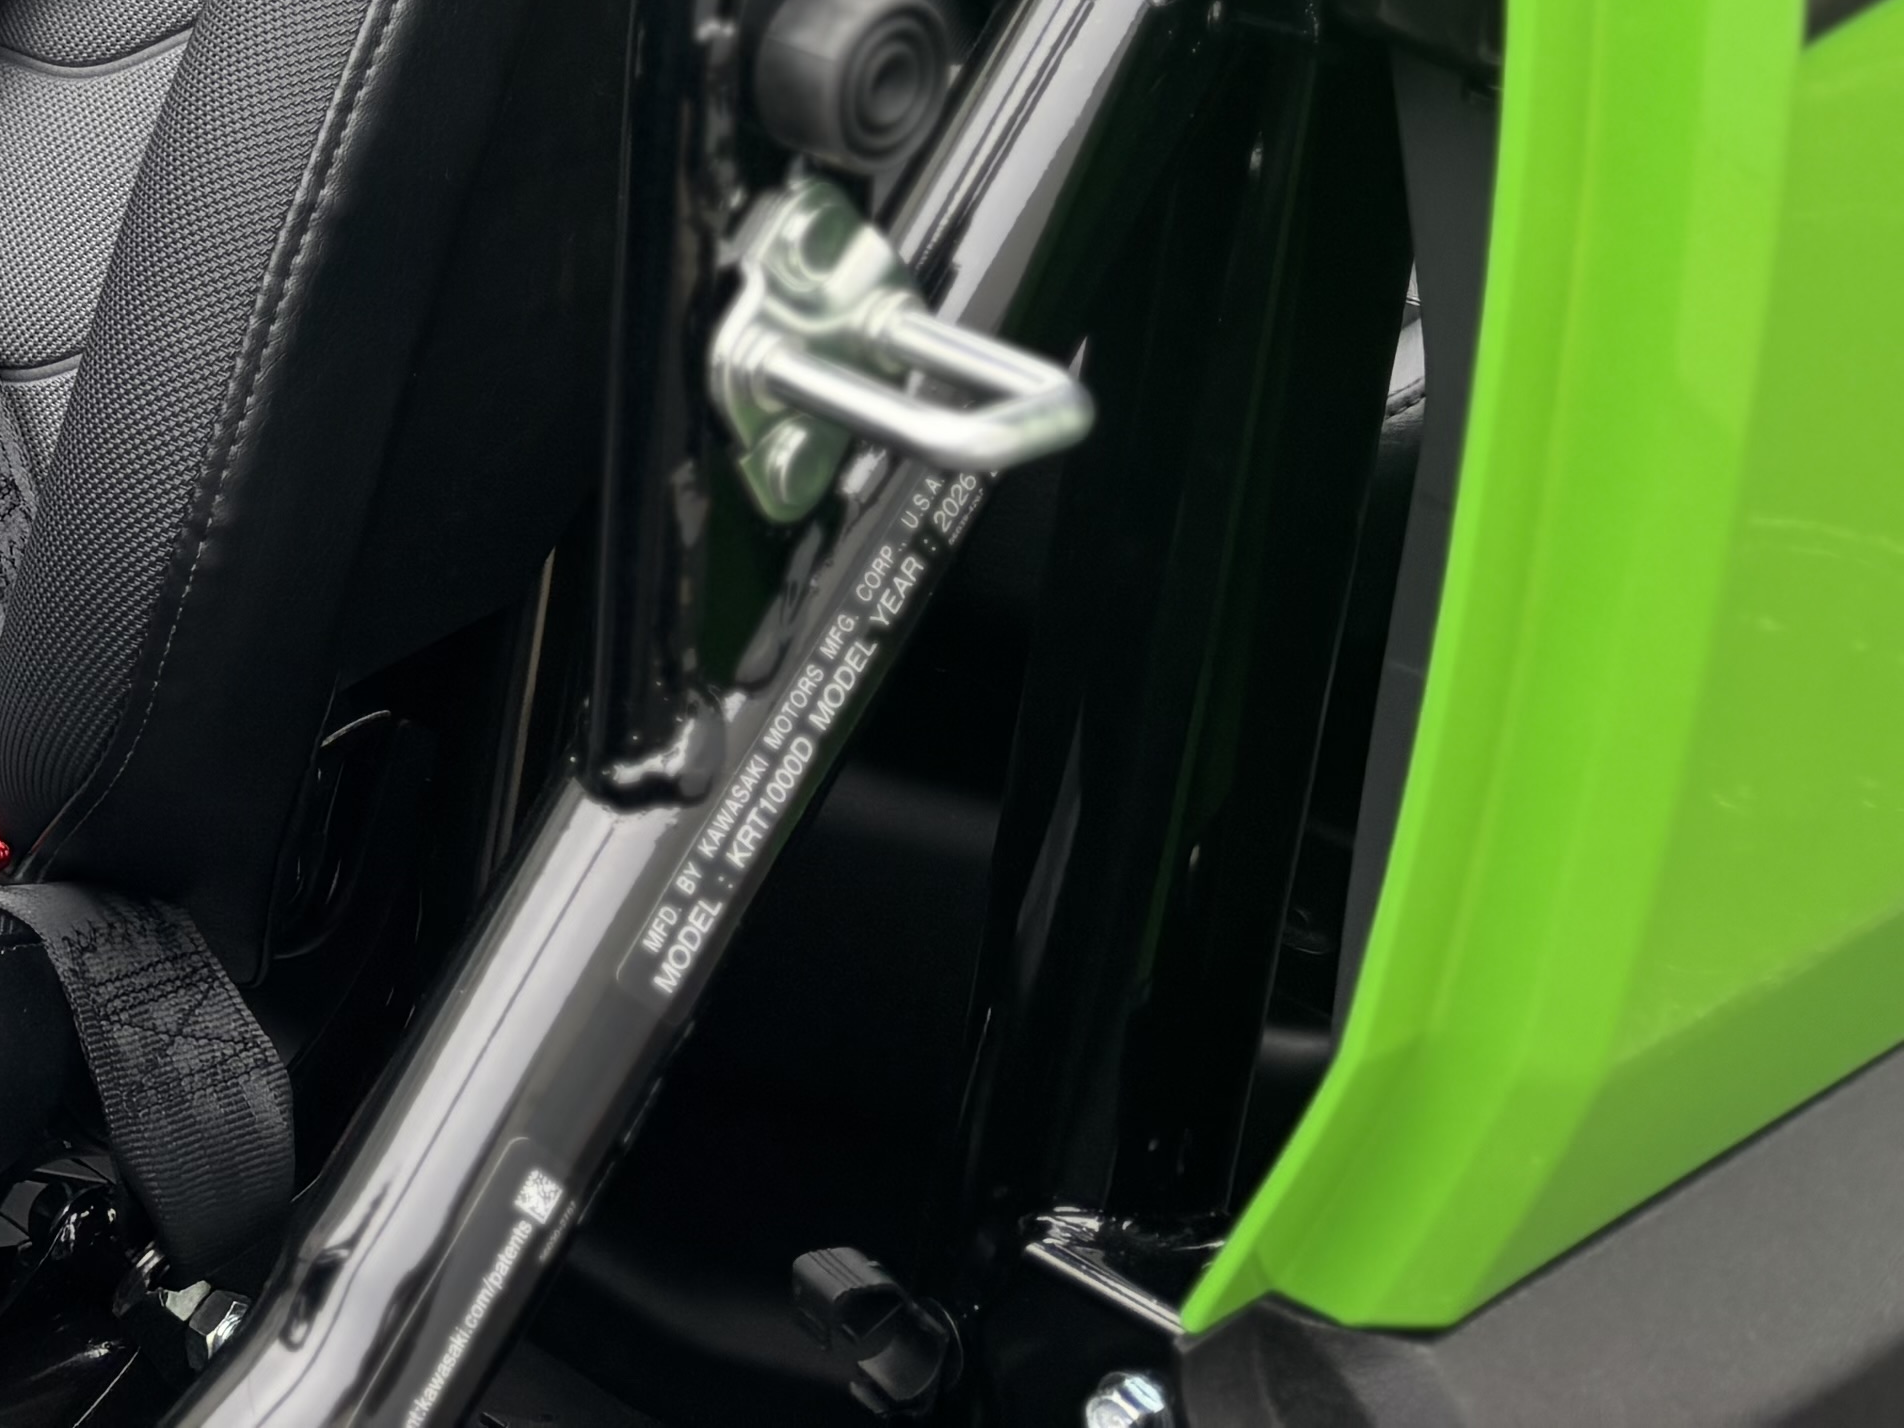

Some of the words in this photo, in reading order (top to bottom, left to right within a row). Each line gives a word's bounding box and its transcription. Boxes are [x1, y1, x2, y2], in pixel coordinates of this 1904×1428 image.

[643, 905, 682, 953] MFD.
[675, 861, 703, 895] BY
[697, 754, 769, 858] KAWASAKI
[763, 664, 824, 750] MOTORS
[819, 614, 860, 660] MFG.
[901, 477, 945, 529] U.S.A.
[653, 900, 723, 994] MODEL
[726, 737, 813, 868] KRT1000D
[809, 641, 878, 731] MODEL
[869, 556, 925, 626] YEAR
[933, 472, 977, 533] 2026
